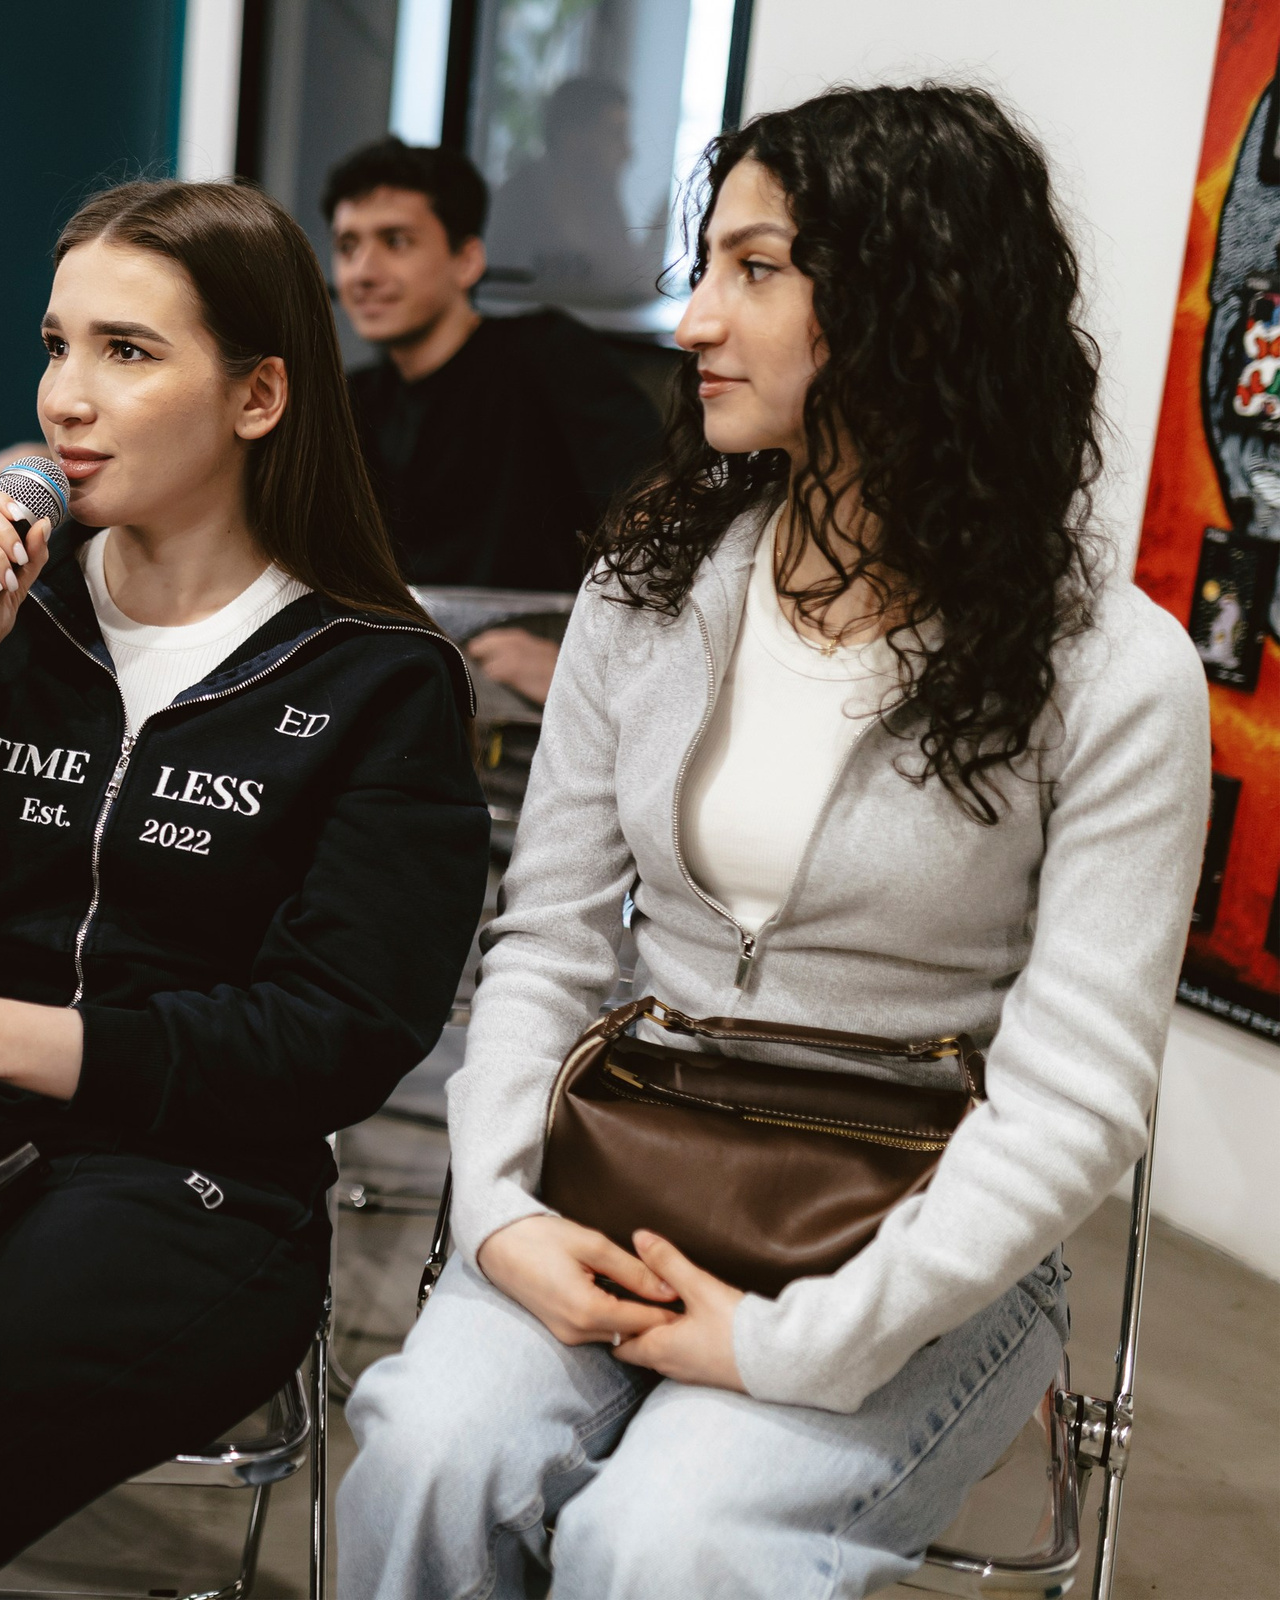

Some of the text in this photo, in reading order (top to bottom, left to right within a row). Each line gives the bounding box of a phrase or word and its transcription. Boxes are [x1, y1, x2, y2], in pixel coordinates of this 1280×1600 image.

[274, 703, 331, 739] ED
[151, 765, 265, 817] LESS
[18, 796, 213, 856] Est. 2022
[183, 1169, 225, 1210] ED
